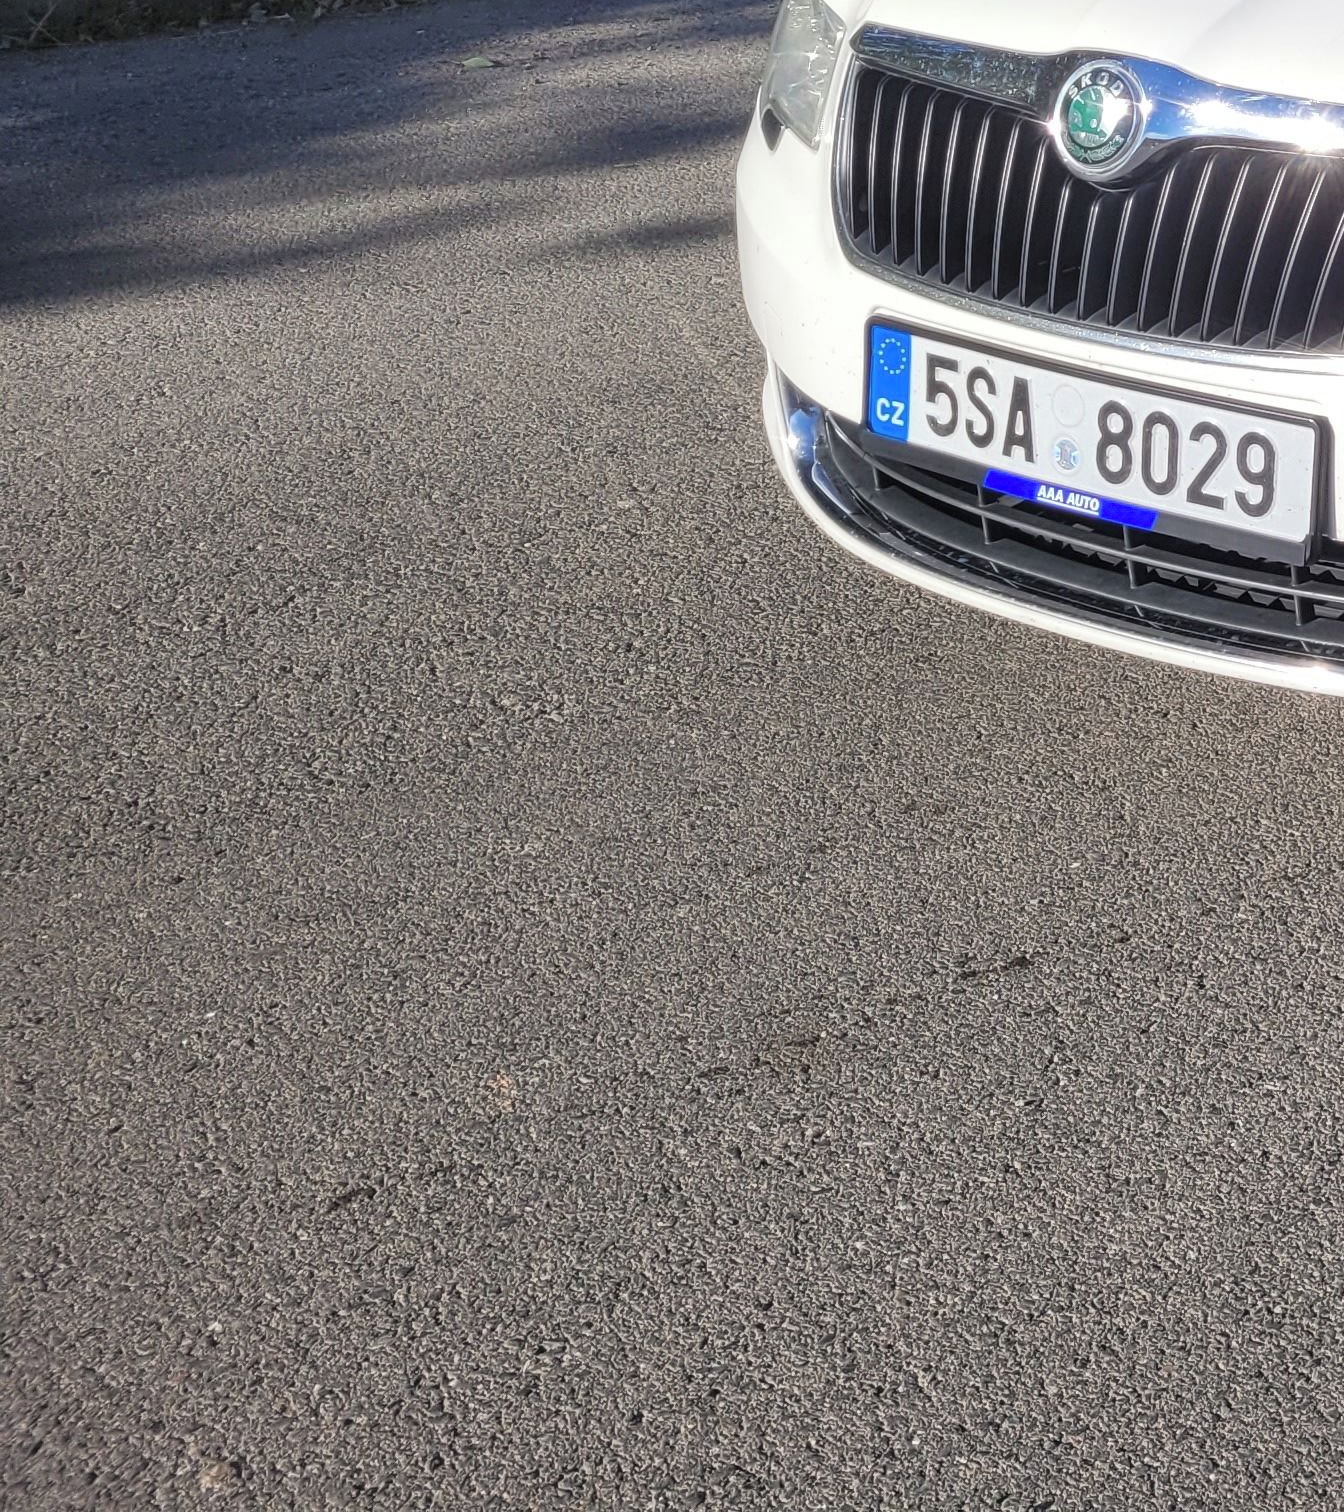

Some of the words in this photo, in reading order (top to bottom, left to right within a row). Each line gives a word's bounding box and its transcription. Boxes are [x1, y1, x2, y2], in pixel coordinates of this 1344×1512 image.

[876, 397, 905, 426] CZ
[924, 352, 1036, 464] 5SA
[1096, 399, 1278, 518] 8029
